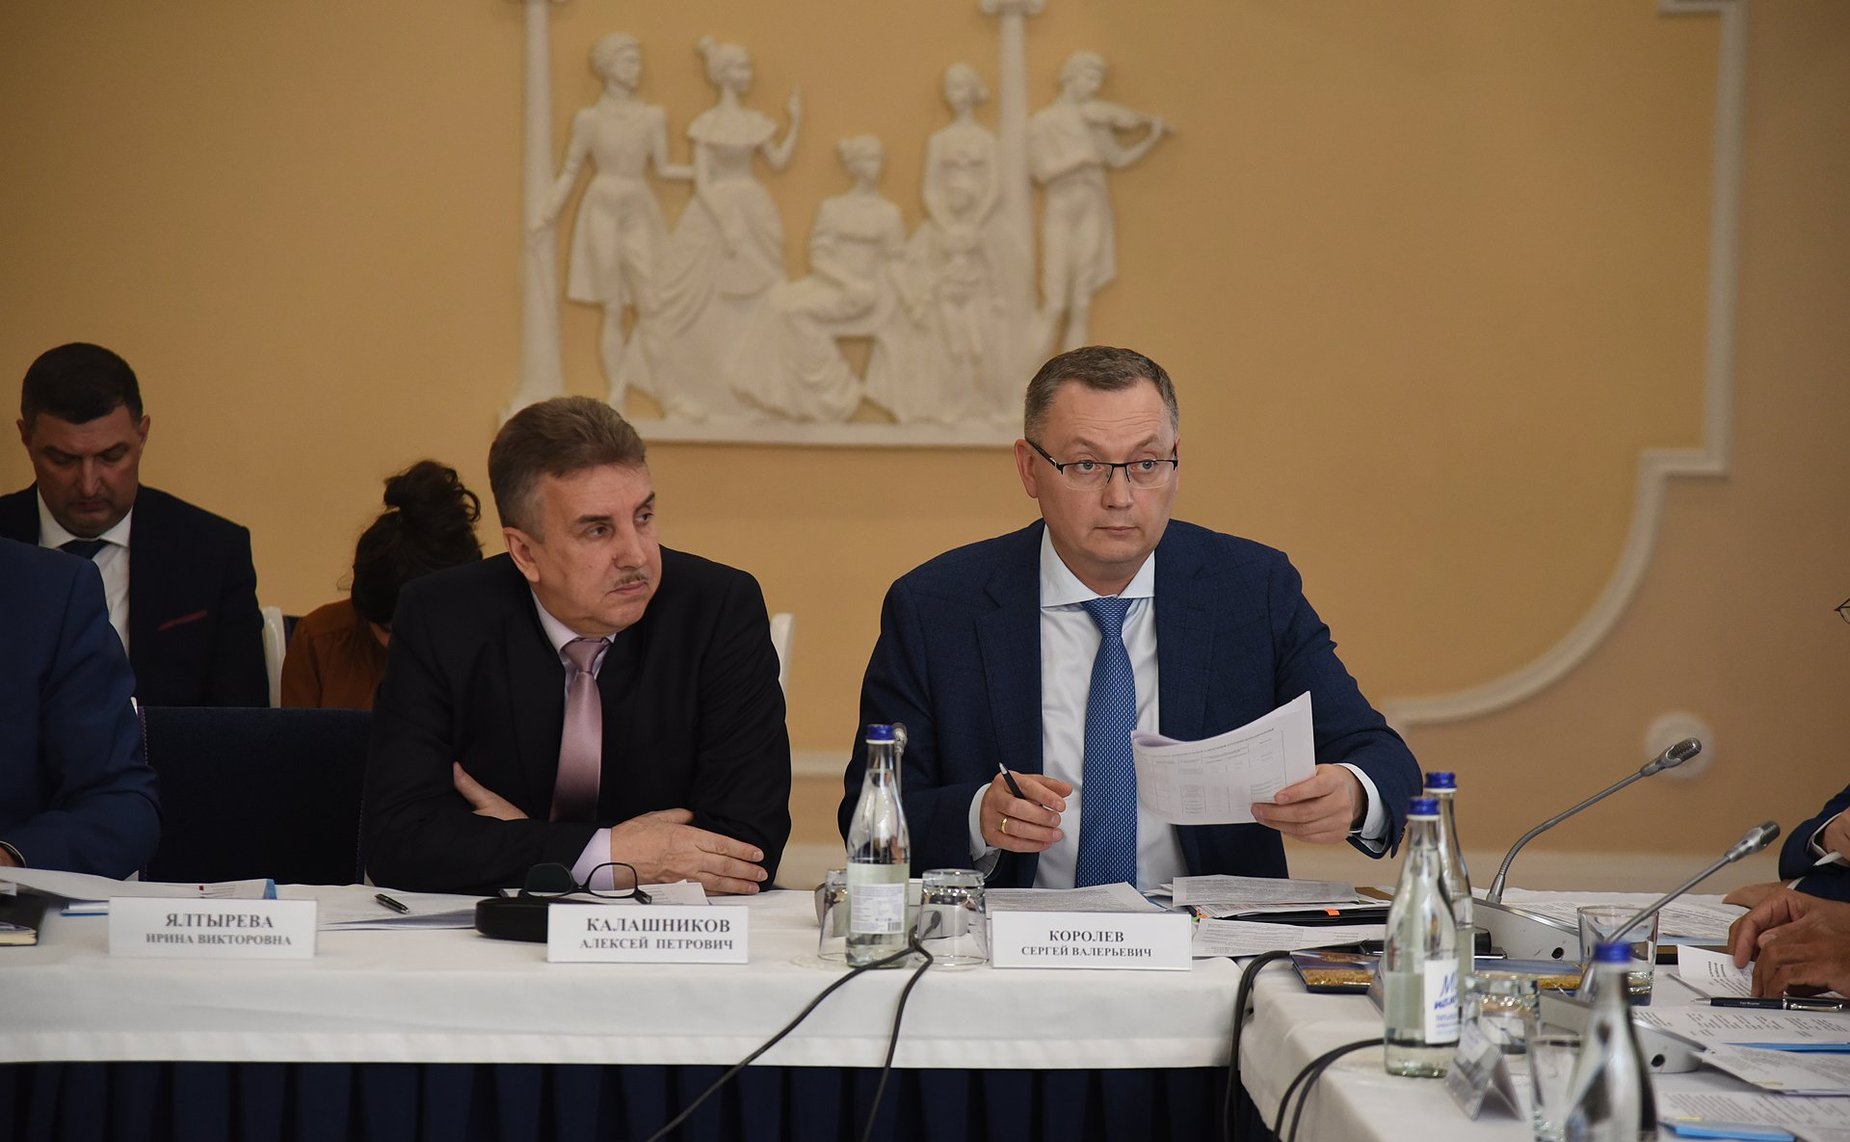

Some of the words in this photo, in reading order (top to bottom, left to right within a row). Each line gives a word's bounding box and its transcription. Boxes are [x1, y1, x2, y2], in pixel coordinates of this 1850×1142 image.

[165, 913, 274, 929] ЯЛТЫРЕВА
[586, 918, 731, 933] КАЛАШНИКОВ
[145, 933, 194, 945] ИРИНА
[197, 934, 292, 946] ВИКТОРОВНА
[579, 936, 649, 950] АЛЕКСЕЙ
[656, 938, 733, 950] ПЕТРОВИЧ
[1049, 930, 1125, 943] КОРОЛЕВ
[1021, 945, 1069, 956] СЕРГЕЙ
[1072, 947, 1152, 957] ВАЛЕРЬЕВИЧ
